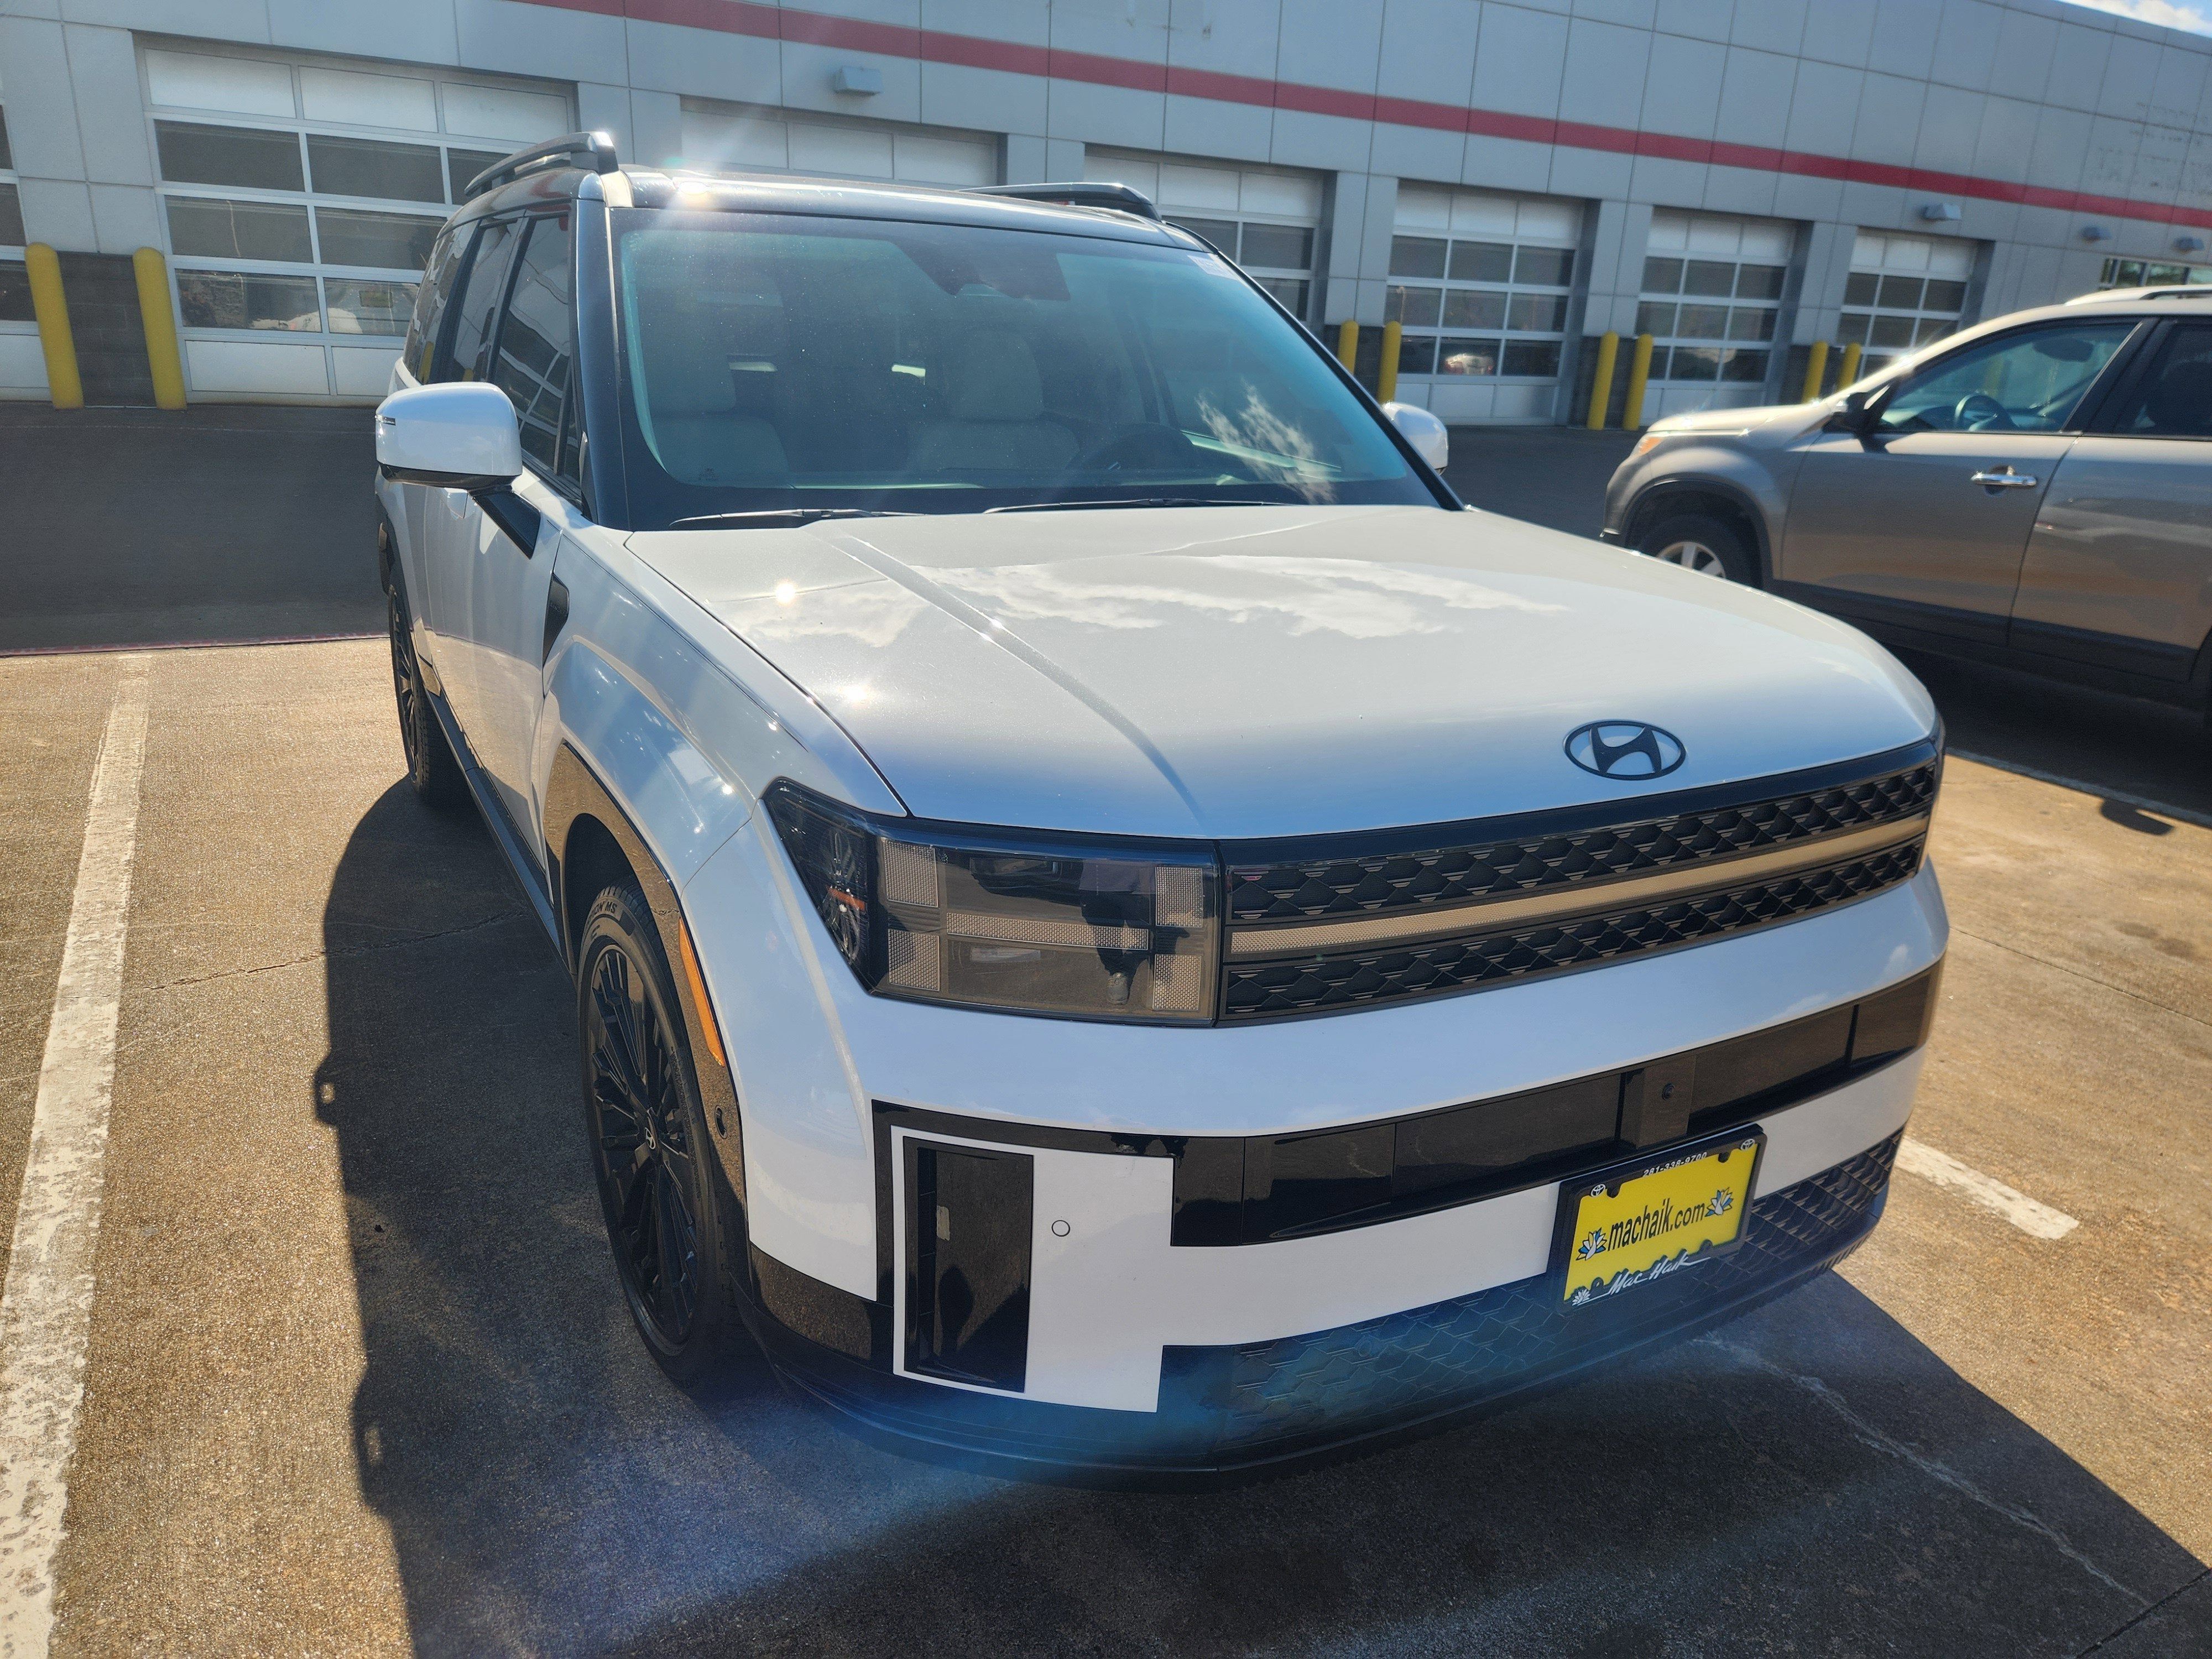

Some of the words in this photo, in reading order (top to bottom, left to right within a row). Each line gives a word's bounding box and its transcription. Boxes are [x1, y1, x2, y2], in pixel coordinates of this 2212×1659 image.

[1642, 1152, 1707, 1177] 281-338-9700
[1608, 1198, 1705, 1251] machaik.com
[1608, 1269, 1647, 1295] Mac
[1648, 1251, 1710, 1280] Haik
